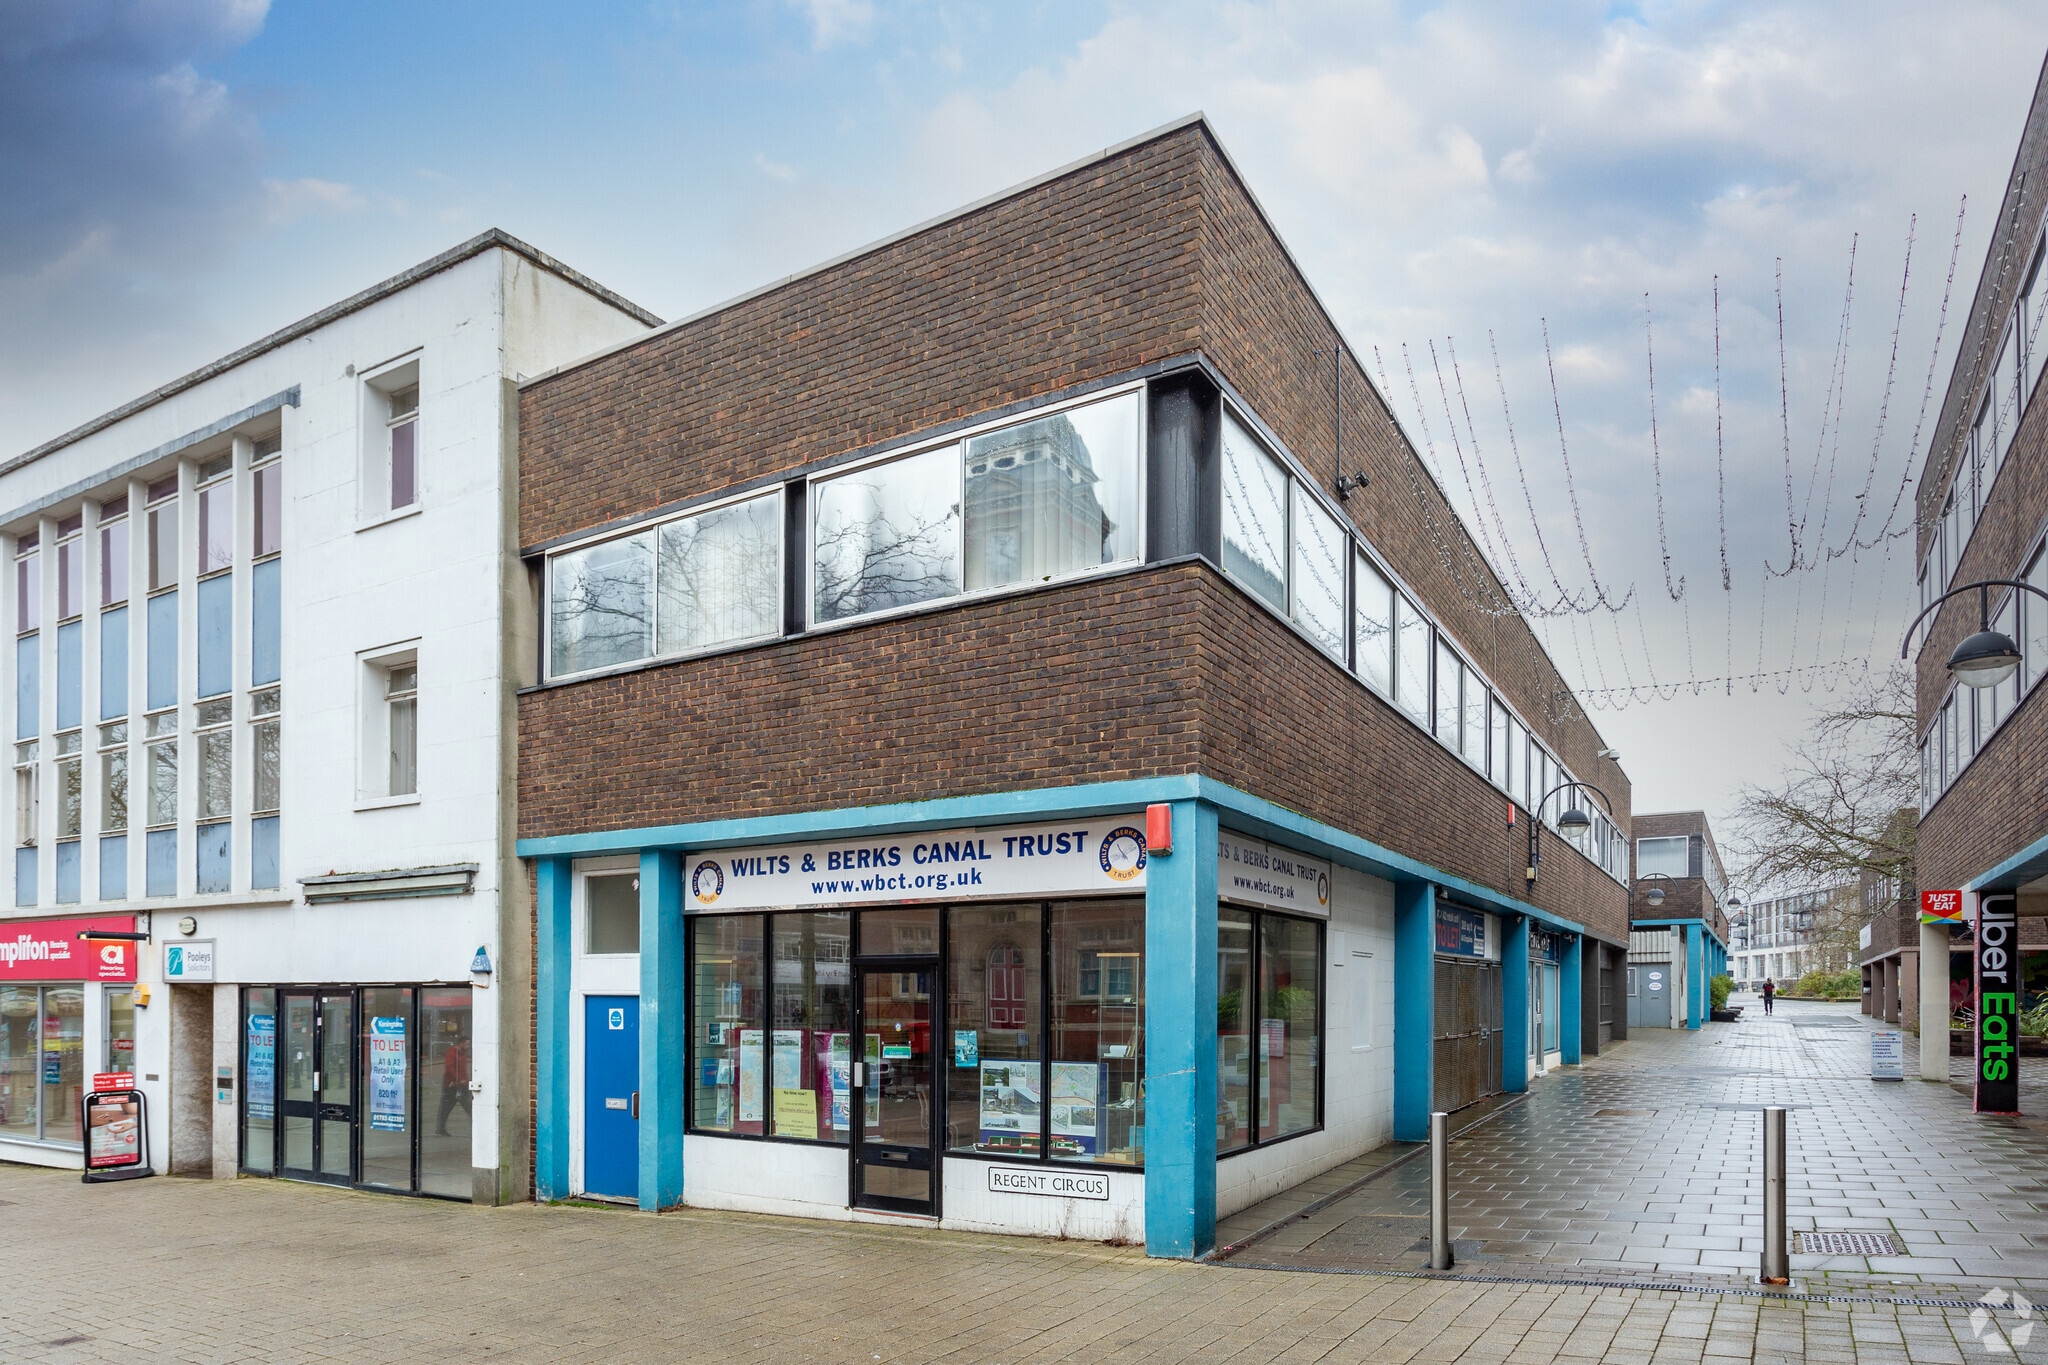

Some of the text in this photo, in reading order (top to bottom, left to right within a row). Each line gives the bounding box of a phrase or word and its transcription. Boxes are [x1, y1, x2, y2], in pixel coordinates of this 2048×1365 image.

[1115, 829, 1138, 838] BERKS
[1138, 838, 1146, 861] CANAL
[731, 831, 1088, 877] WILTS & BERKS CANAL TRUST
[1218, 841, 1316, 882] TS & BERKS CANAL TRUST
[1114, 870, 1135, 878] TRUST
[812, 867, 982, 894] www.wbct.org.uk
[1234, 876, 1294, 899] www.wbct.org.uk
[1928, 893, 1956, 904] JUST
[1934, 902, 1956, 910] EAT
[1437, 923, 1446, 947] TO
[1448, 926, 1459, 948] LET
[188, 952, 211, 962] Pooleys
[188, 964, 210, 972] Solicitors
[1981, 894, 2015, 1081] Uber Eats
[250, 1035, 275, 1046] TO LE
[373, 1040, 405, 1051] TO LET
[391, 1067, 403, 1075] Uses
[381, 1076, 394, 1084] Only
[379, 1090, 389, 1098] 820
[994, 1174, 1102, 1194] REGENT CIRCUS
